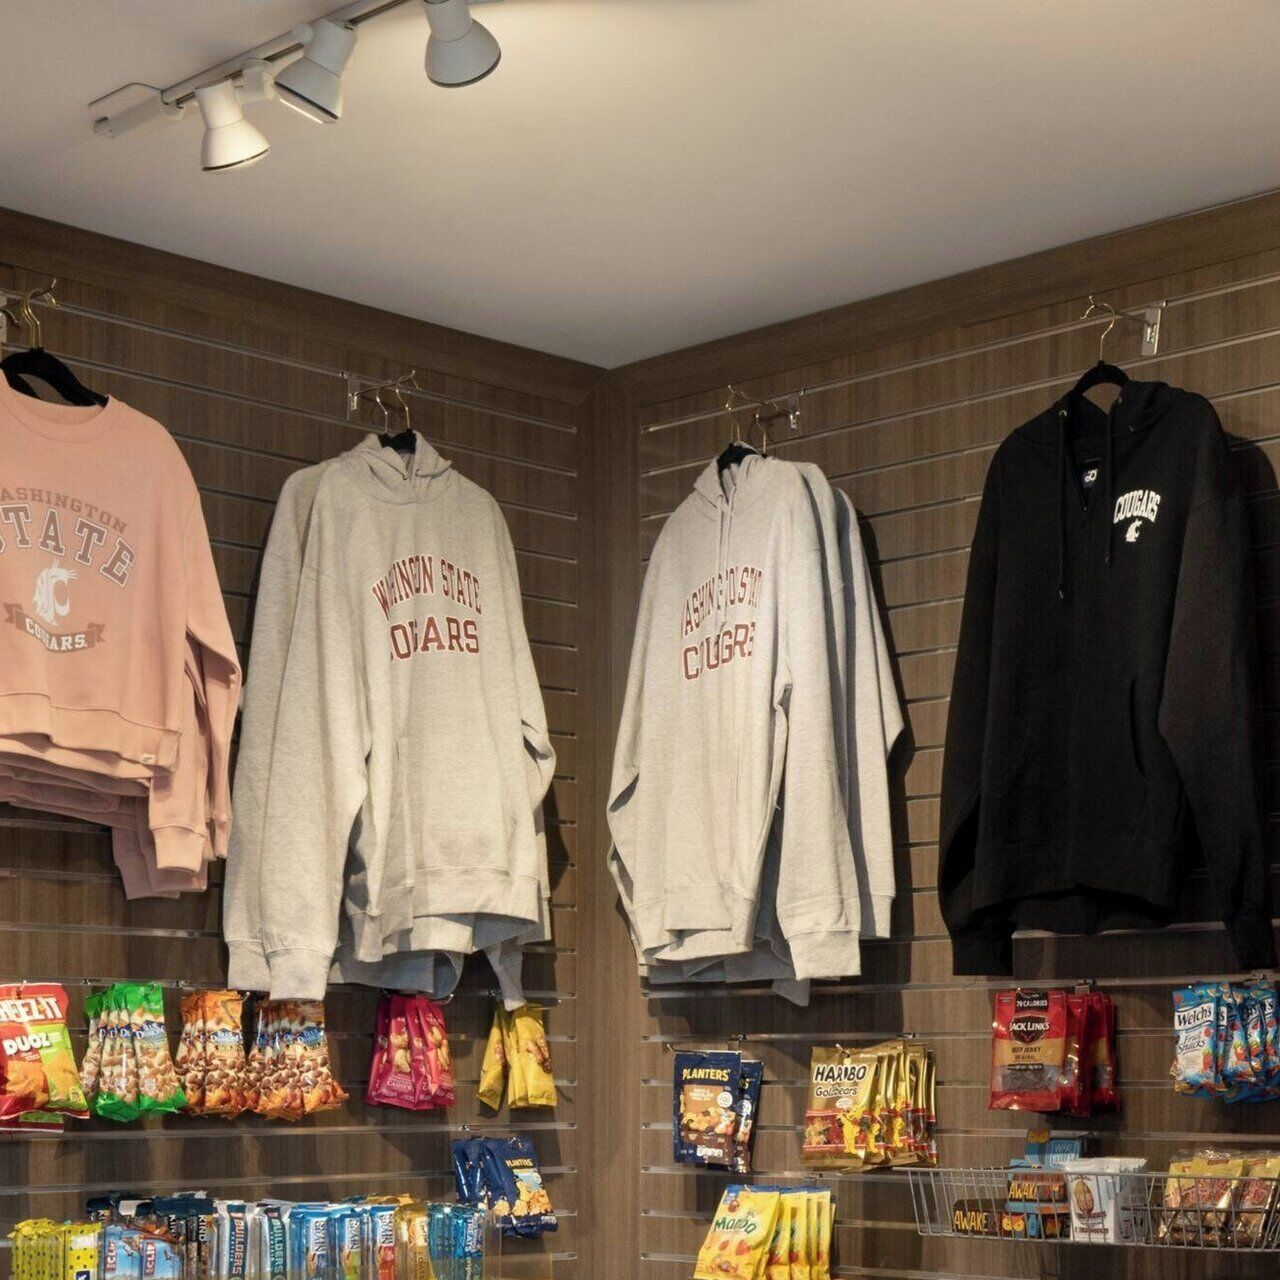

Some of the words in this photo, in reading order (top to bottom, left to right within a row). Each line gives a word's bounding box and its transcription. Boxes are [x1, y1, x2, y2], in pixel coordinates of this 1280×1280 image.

[1113, 490, 1161, 524] COUGARS
[25, 617, 87, 650] COUGARS
[1009, 1022, 1028, 1032] JACK
[1175, 1008, 1213, 1027] Welch's
[3, 1032, 51, 1056] DUOZ
[682, 1068, 731, 1081] PLANTERS
[814, 1065, 867, 1082] HARIBO
[198, 1215, 206, 1242] KIND
[954, 1211, 988, 1233] AWAKE
[232, 1218, 246, 1275] BUILDERS
[273, 1218, 285, 1273] BUILDERS
